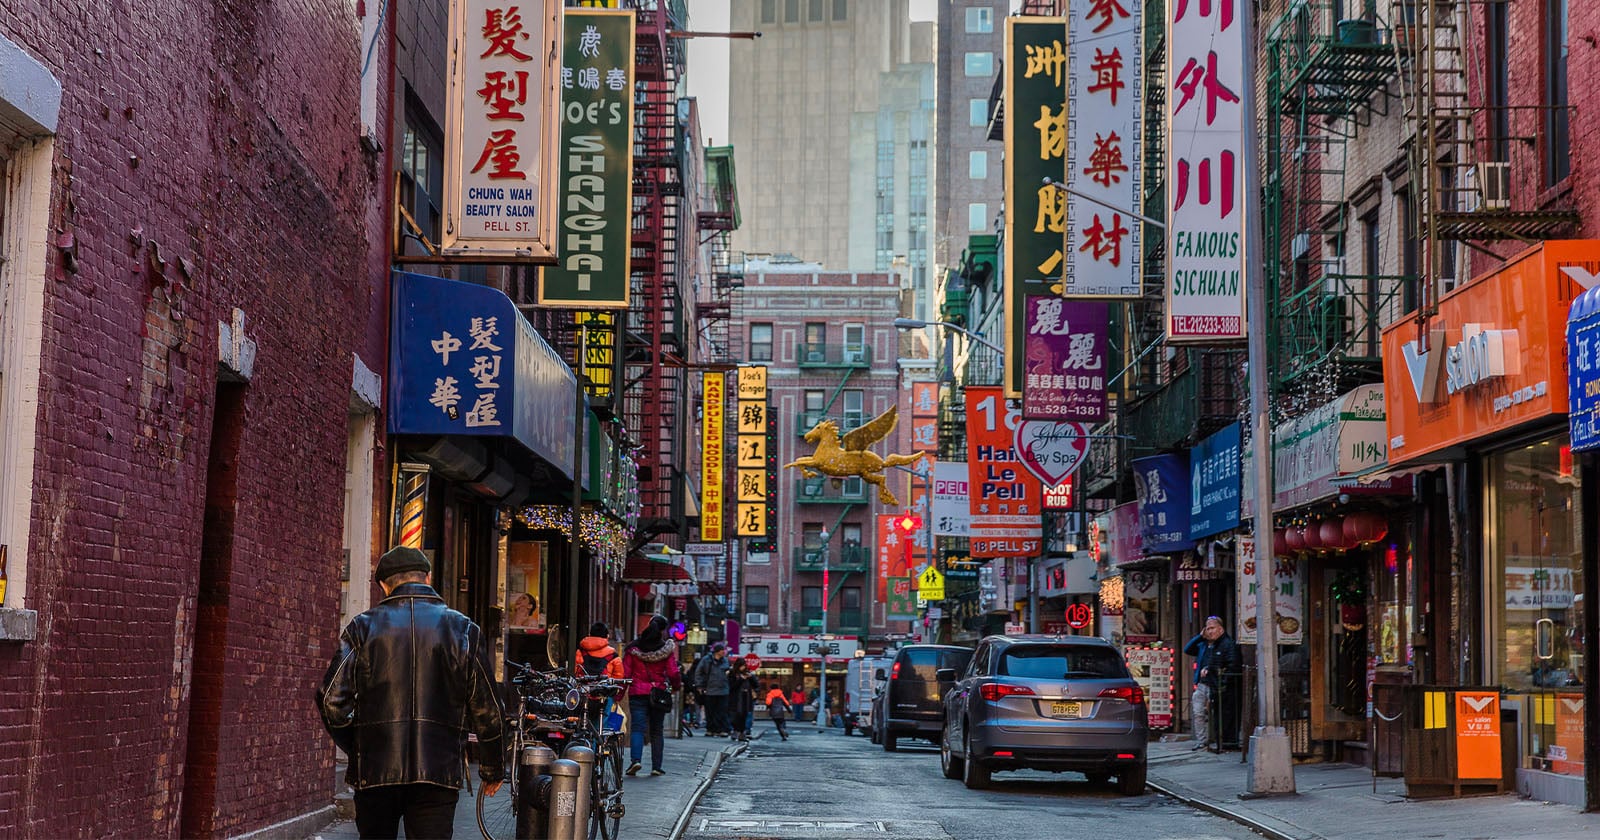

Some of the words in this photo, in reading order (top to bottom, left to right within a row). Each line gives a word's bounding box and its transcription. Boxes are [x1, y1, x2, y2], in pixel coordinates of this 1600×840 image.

[470, 6, 533, 180] 髮型屋
[561, 99, 622, 125] OE'S
[469, 187, 504, 200] CHUNG
[510, 188, 533, 201] WAH
[466, 204, 501, 217] BEAUTY
[506, 205, 535, 217] SALON
[564, 135, 607, 291] SHANGHAI
[484, 221, 510, 232] PELL
[515, 221, 530, 232] ST.
[1175, 230, 1239, 258] FAMOUS
[1173, 269, 1239, 297] SICHUAN
[1401, 329, 1446, 404] V
[1447, 323, 1494, 396] salon
[429, 331, 462, 414] 中華
[743, 371, 761, 380] Joe's
[739, 383, 765, 395] Ginger
[1369, 390, 1384, 401] Dine
[977, 445, 1020, 463] Hai
[1026, 450, 1049, 466] Day
[1052, 451, 1077, 466] Spa
[705, 443, 720, 487] NOODLES
[739, 404, 766, 532] 錦江飯店
[987, 465, 1016, 482] Le
[936, 481, 968, 494] PEL
[982, 482, 1025, 500] Pell
[1046, 495, 1068, 507] RUB
[973, 541, 987, 553] 18
[989, 540, 1021, 552] PELL
[1022, 541, 1038, 552] ST
[1073, 604, 1086, 621] 18
